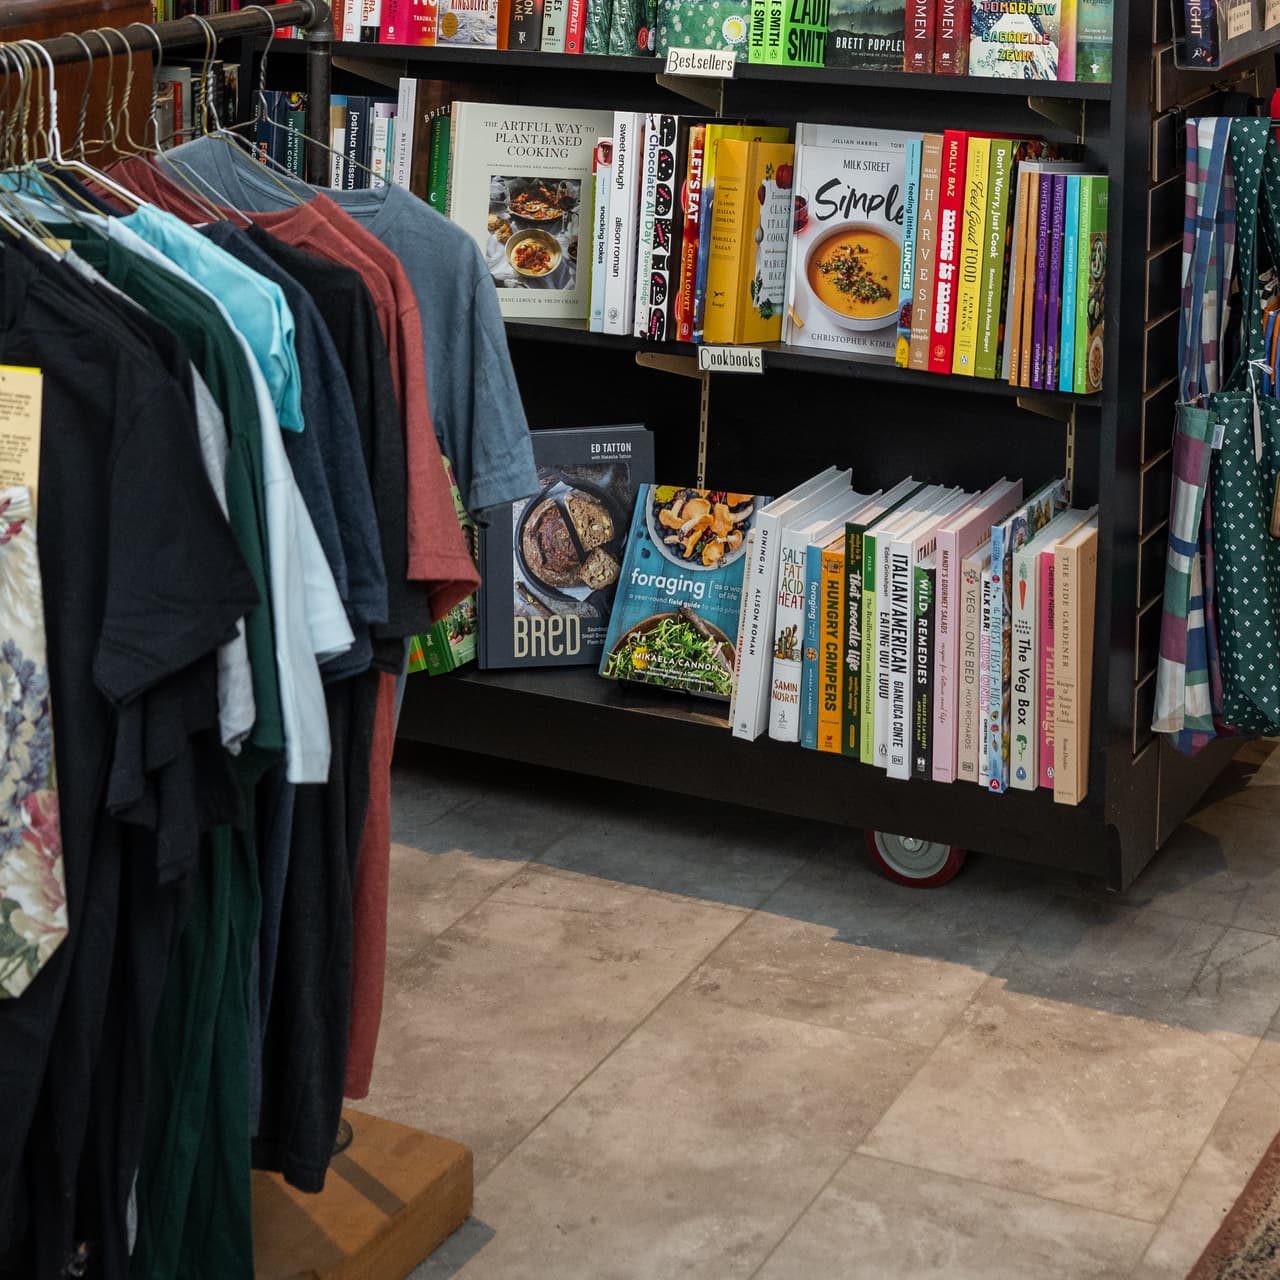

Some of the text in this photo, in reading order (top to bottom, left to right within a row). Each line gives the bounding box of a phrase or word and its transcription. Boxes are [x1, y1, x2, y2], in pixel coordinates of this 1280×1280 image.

[980, 1, 1056, 15] TOMORROW
[753, 10, 765, 47] SMITH
[982, 31, 1049, 45] GABRIELLE
[668, 51, 733, 73] Bestsellers
[998, 50, 1033, 62] ZEVIN
[500, 121, 551, 132] ARTFUL
[556, 123, 583, 134] WAY
[507, 146, 569, 159] COOKING
[843, 160, 890, 172] MILK STREET
[947, 140, 958, 197] MOLLY BAZ
[687, 148, 703, 223] LET'S EAT
[816, 178, 904, 224] Simple
[700, 349, 760, 369] Cookbooks
[591, 442, 631, 452] ED TATTON
[782, 547, 806, 563] SALT
[784, 564, 801, 578] FAT
[631, 569, 705, 599] foraging
[781, 580, 804, 593] ACID
[779, 594, 804, 610] HEAT
[892, 554, 908, 674] ITALIAN/AMERICAN
[917, 580, 928, 685] WILD REMEDIES
[824, 580, 840, 712] HUNGRY CAMPERS
[634, 652, 719, 672] MIKAELA CANNON
[774, 679, 798, 692] SAMIN
[1015, 640, 1031, 725] The Veg Box
[772, 691, 798, 704] NOSRAT
